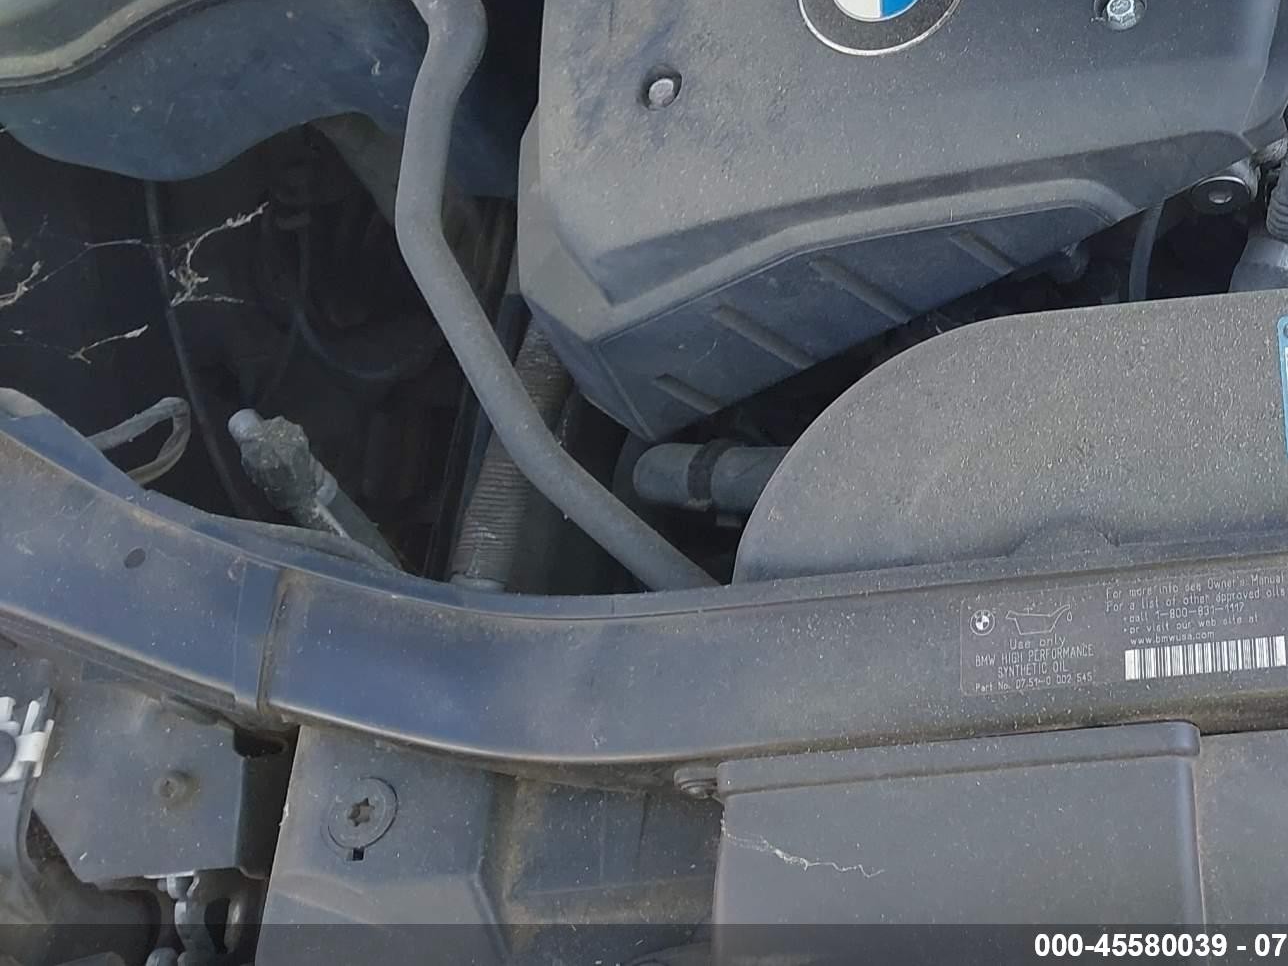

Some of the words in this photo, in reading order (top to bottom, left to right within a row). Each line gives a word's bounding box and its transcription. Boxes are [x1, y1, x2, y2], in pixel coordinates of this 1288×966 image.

[1106, 587, 1122, 599] For
[1130, 586, 1152, 596] more
[1160, 583, 1178, 594] info
[1251, 573, 1284, 586] Manual
[1106, 601, 1123, 612] For
[1142, 596, 1159, 609] list
[1166, 595, 1176, 606] of
[1183, 593, 1209, 605] other
[1216, 587, 1260, 603] approved
[1130, 626, 1139, 634] or
[1147, 621, 1169, 633] visit
[1176, 622, 1191, 630] our
[1199, 618, 1216, 627] web
[1249, 612, 1258, 622] at
[1010, 638, 1031, 649] Use
[1040, 634, 1066, 648] only
[1131, 632, 1214, 645] www.bmwusa.com
[976, 655, 996, 667] BMW
[1002, 652, 1023, 664] HIGH
[1028, 644, 1094, 661] PERFORMANCE
[998, 662, 1048, 678] SYNTHETIC
[1053, 661, 1068, 673] OIL
[976, 682, 993, 692] Part
